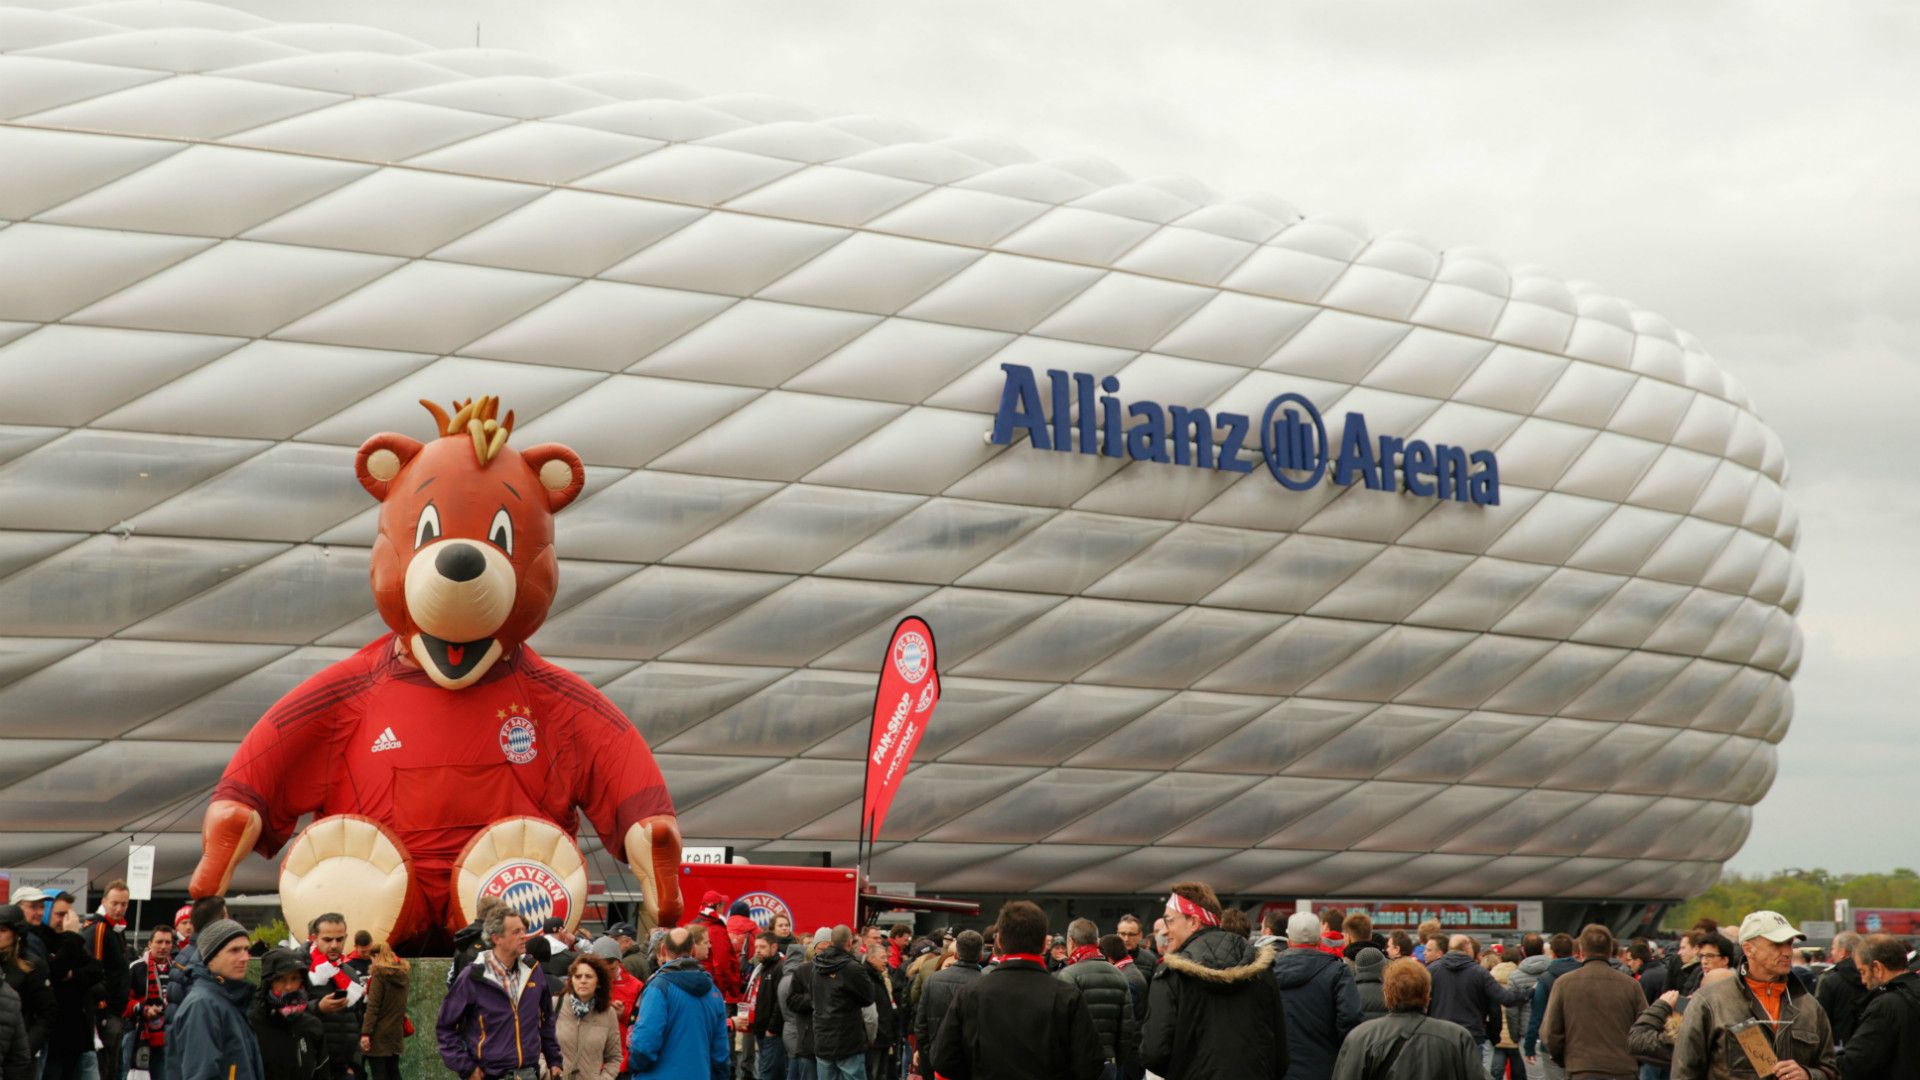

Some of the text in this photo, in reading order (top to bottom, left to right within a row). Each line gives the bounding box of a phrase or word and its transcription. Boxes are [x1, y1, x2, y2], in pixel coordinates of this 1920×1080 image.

[992, 362, 1501, 506] Allianz Arena
[371, 740, 402, 752] adidas
[873, 692, 910, 765] FAN-SHOP
[501, 867, 564, 902] BAYERN
[744, 896, 787, 915] BAYER
